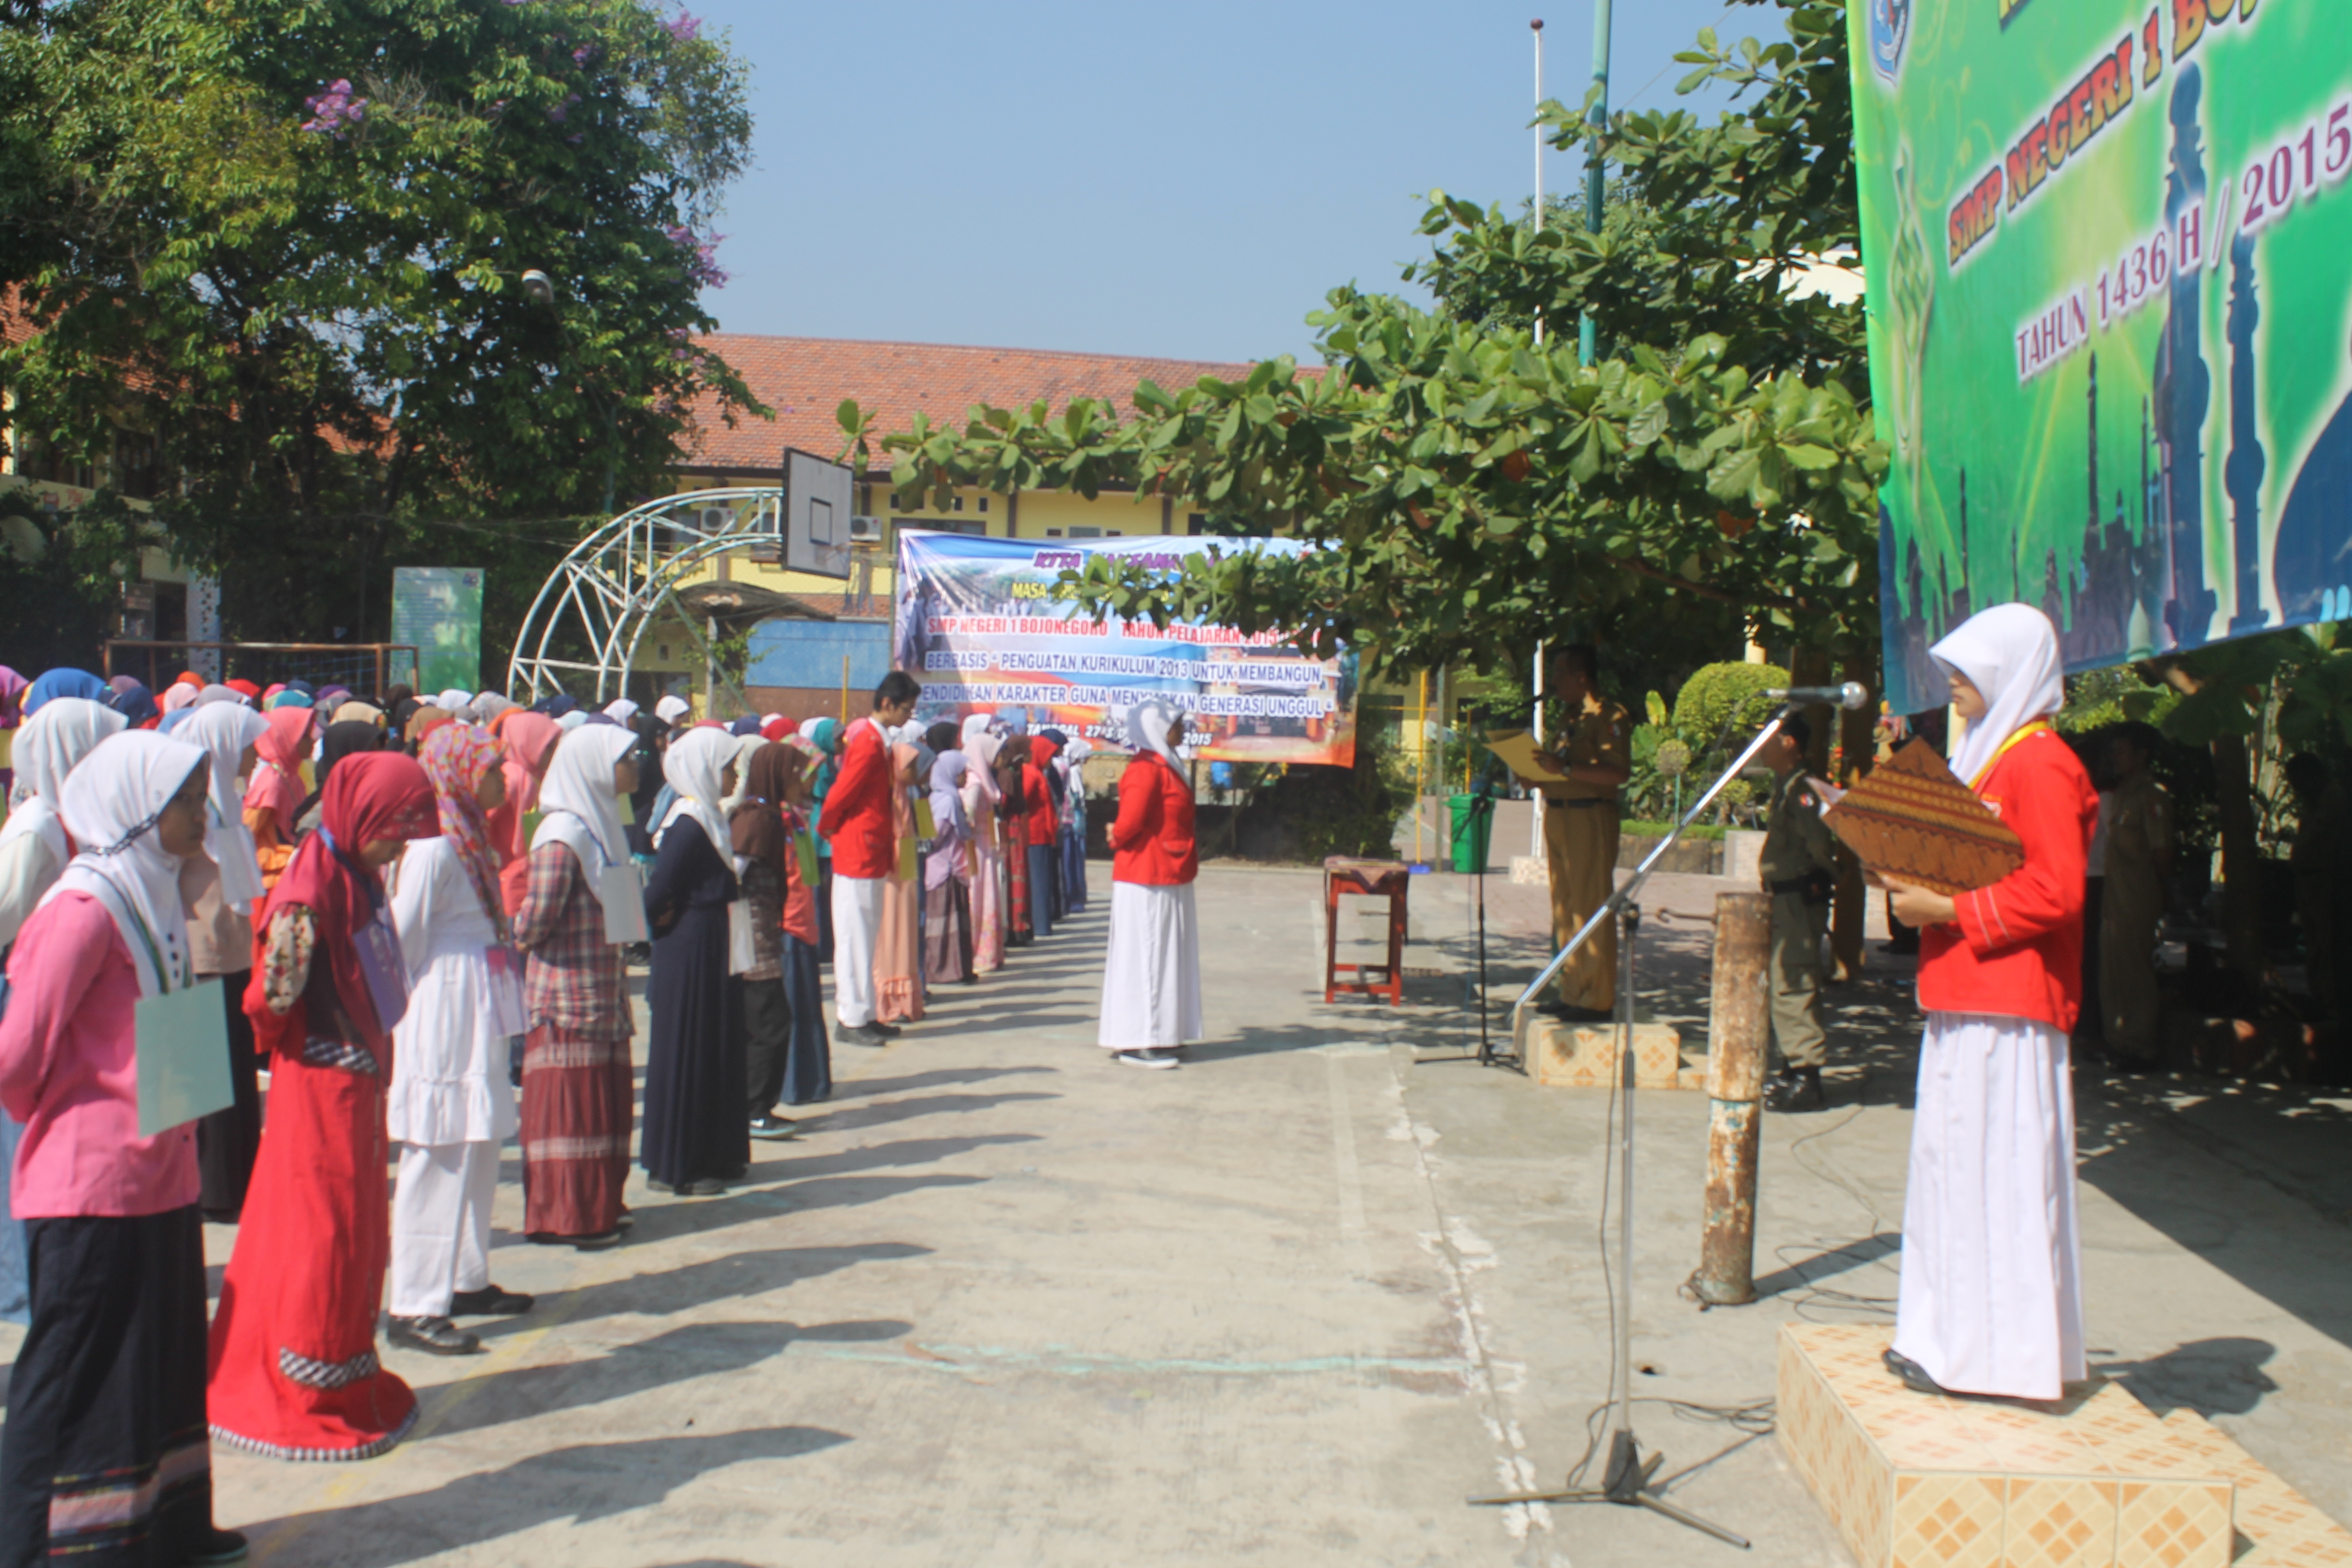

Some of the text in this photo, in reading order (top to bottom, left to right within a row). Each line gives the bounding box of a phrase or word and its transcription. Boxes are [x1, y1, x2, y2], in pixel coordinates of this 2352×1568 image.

[1950, 165, 2002, 266] SMP
[2006, 32, 2133, 213] NEGERI
[2143, 7, 2162, 90] 1
[2017, 103, 2351, 375] TAHUN 1436 H / 2015
[1034, 552, 1081, 568] KITA
[1011, 582, 1046, 599] MASA
[928, 618, 957, 633] SMP
[960, 618, 1007, 633] NEGERI
[1011, 619, 1016, 633] 1
[1020, 619, 1108, 636] BOJONEGORO
[1121, 622, 1164, 639] TAHUN
[1169, 625, 1239, 645] PELAJARAN
[928, 653, 987, 668] BERBASIS
[1001, 654, 1076, 670] PENGUATAN
[1081, 655, 1155, 673] KURIKULUM
[1159, 660, 1188, 676] 2013
[1193, 663, 1233, 678] UNTUK
[1239, 665, 1320, 682] MEMBANGUN
[921, 685, 992, 701] ENDIDIKAN
[997, 685, 1065, 701] KARAKTER
[1070, 688, 1107, 703] GUNA
[1200, 696, 1264, 715] GENERASI
[1268, 699, 1322, 715] UNGGUL
[1084, 724, 1102, 738] 27
[1183, 732, 1212, 745] 2015
